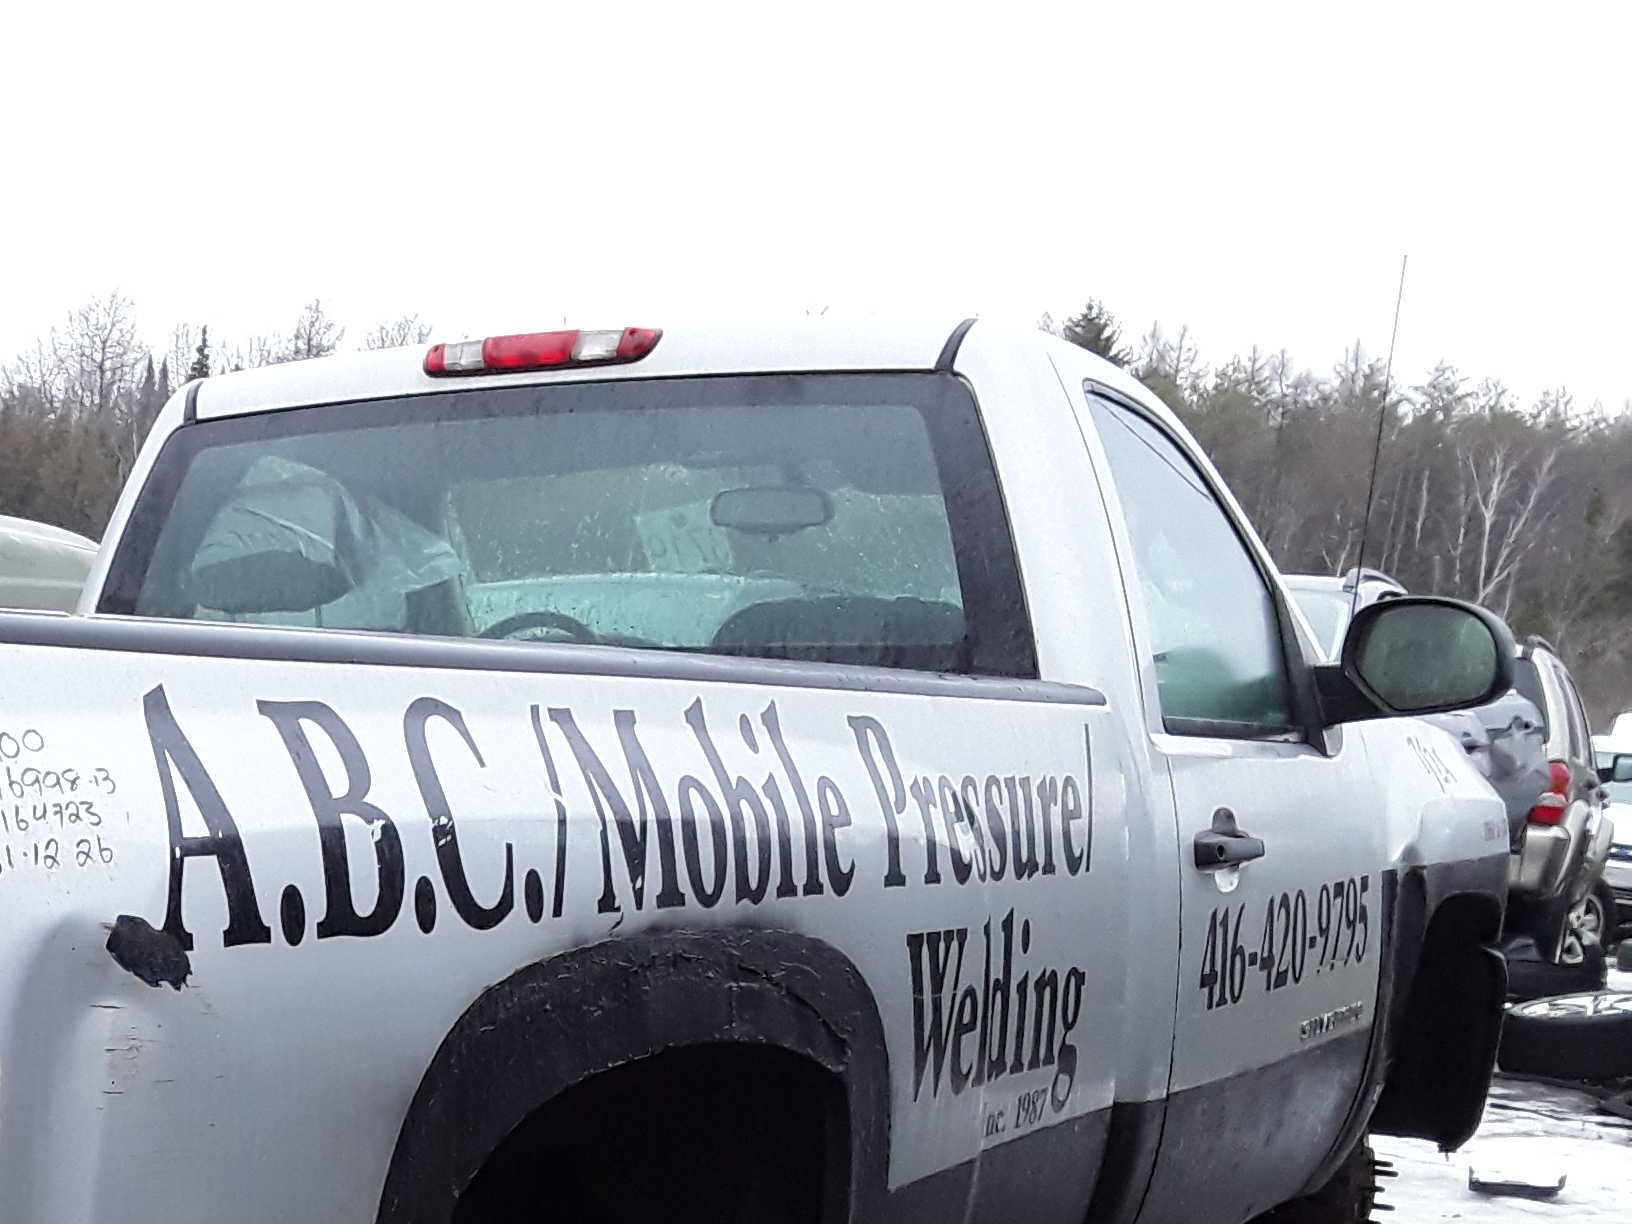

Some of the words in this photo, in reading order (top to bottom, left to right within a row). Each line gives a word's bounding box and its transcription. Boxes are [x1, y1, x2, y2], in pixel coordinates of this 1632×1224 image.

[905, 907, 1086, 1113] Welding
[1199, 874, 1370, 1011] 416-420-9795
[1014, 1086, 1048, 1129] 1987
